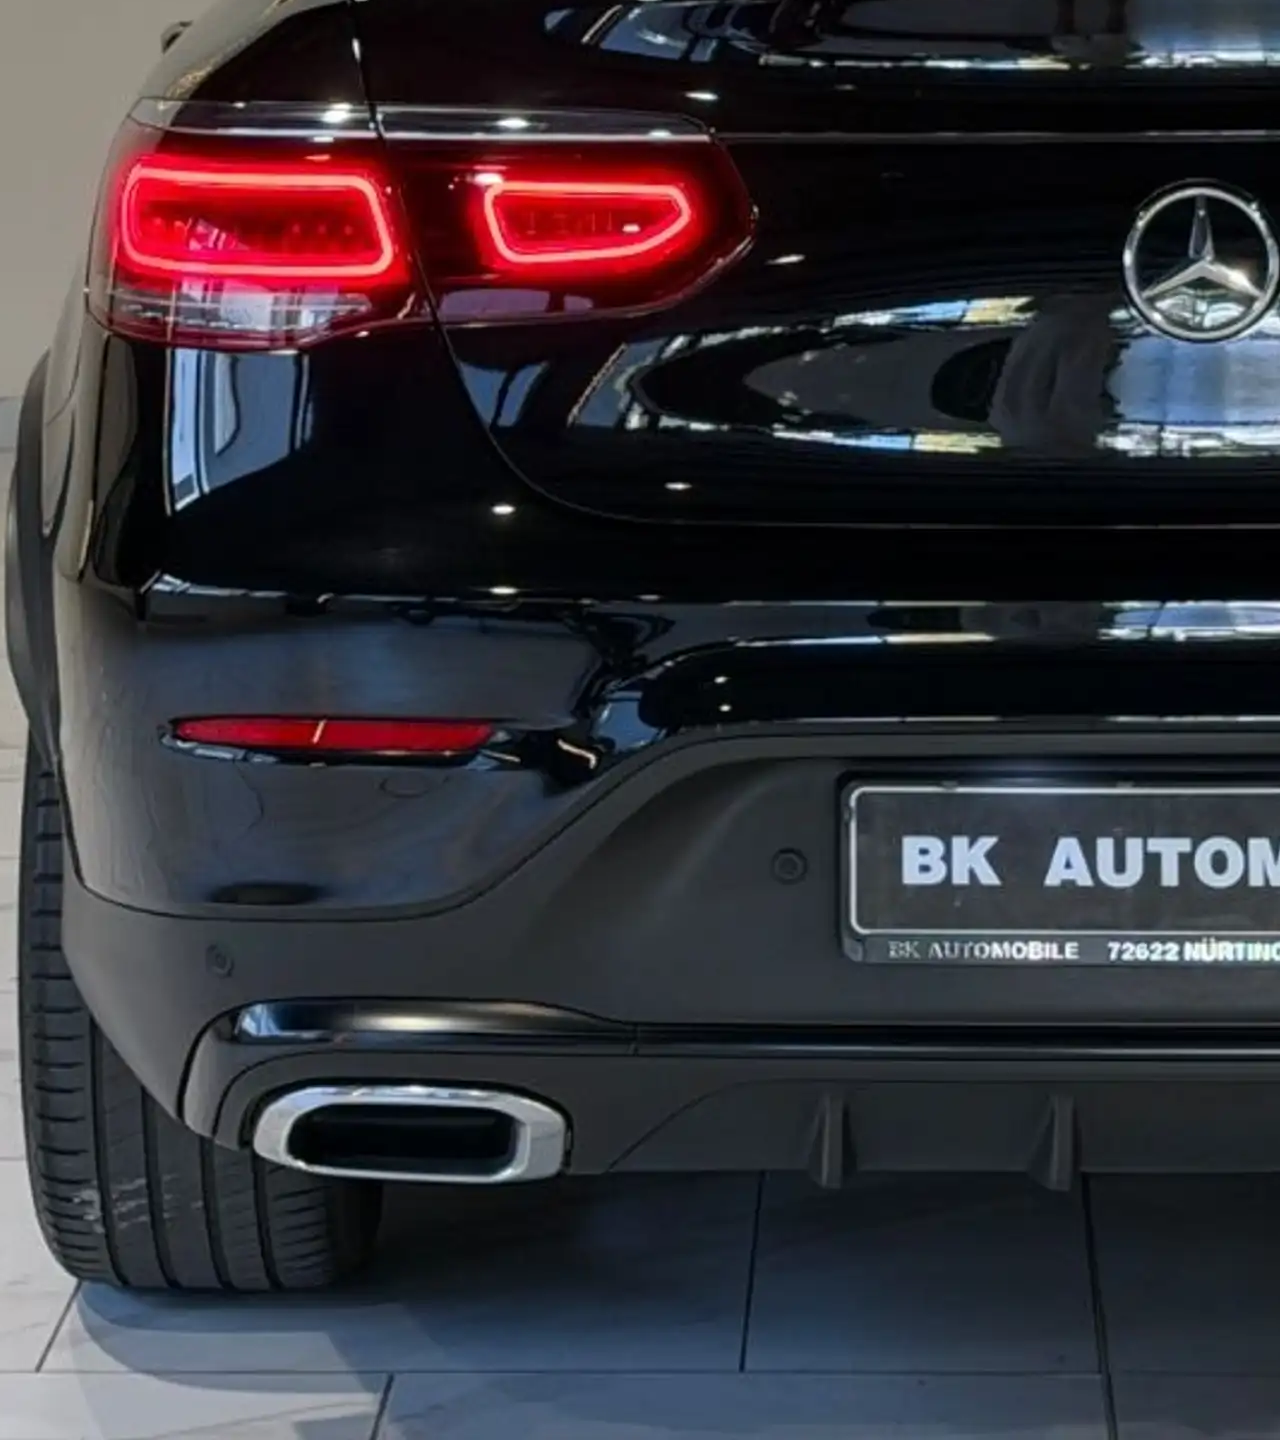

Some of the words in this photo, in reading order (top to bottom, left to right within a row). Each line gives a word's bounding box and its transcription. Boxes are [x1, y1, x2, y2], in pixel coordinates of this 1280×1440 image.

[901, 836, 1001, 886] BK
[888, 940, 920, 959] BK
[928, 940, 1080, 960] AUTOMOBILE
[1107, 941, 1180, 961] 72622
